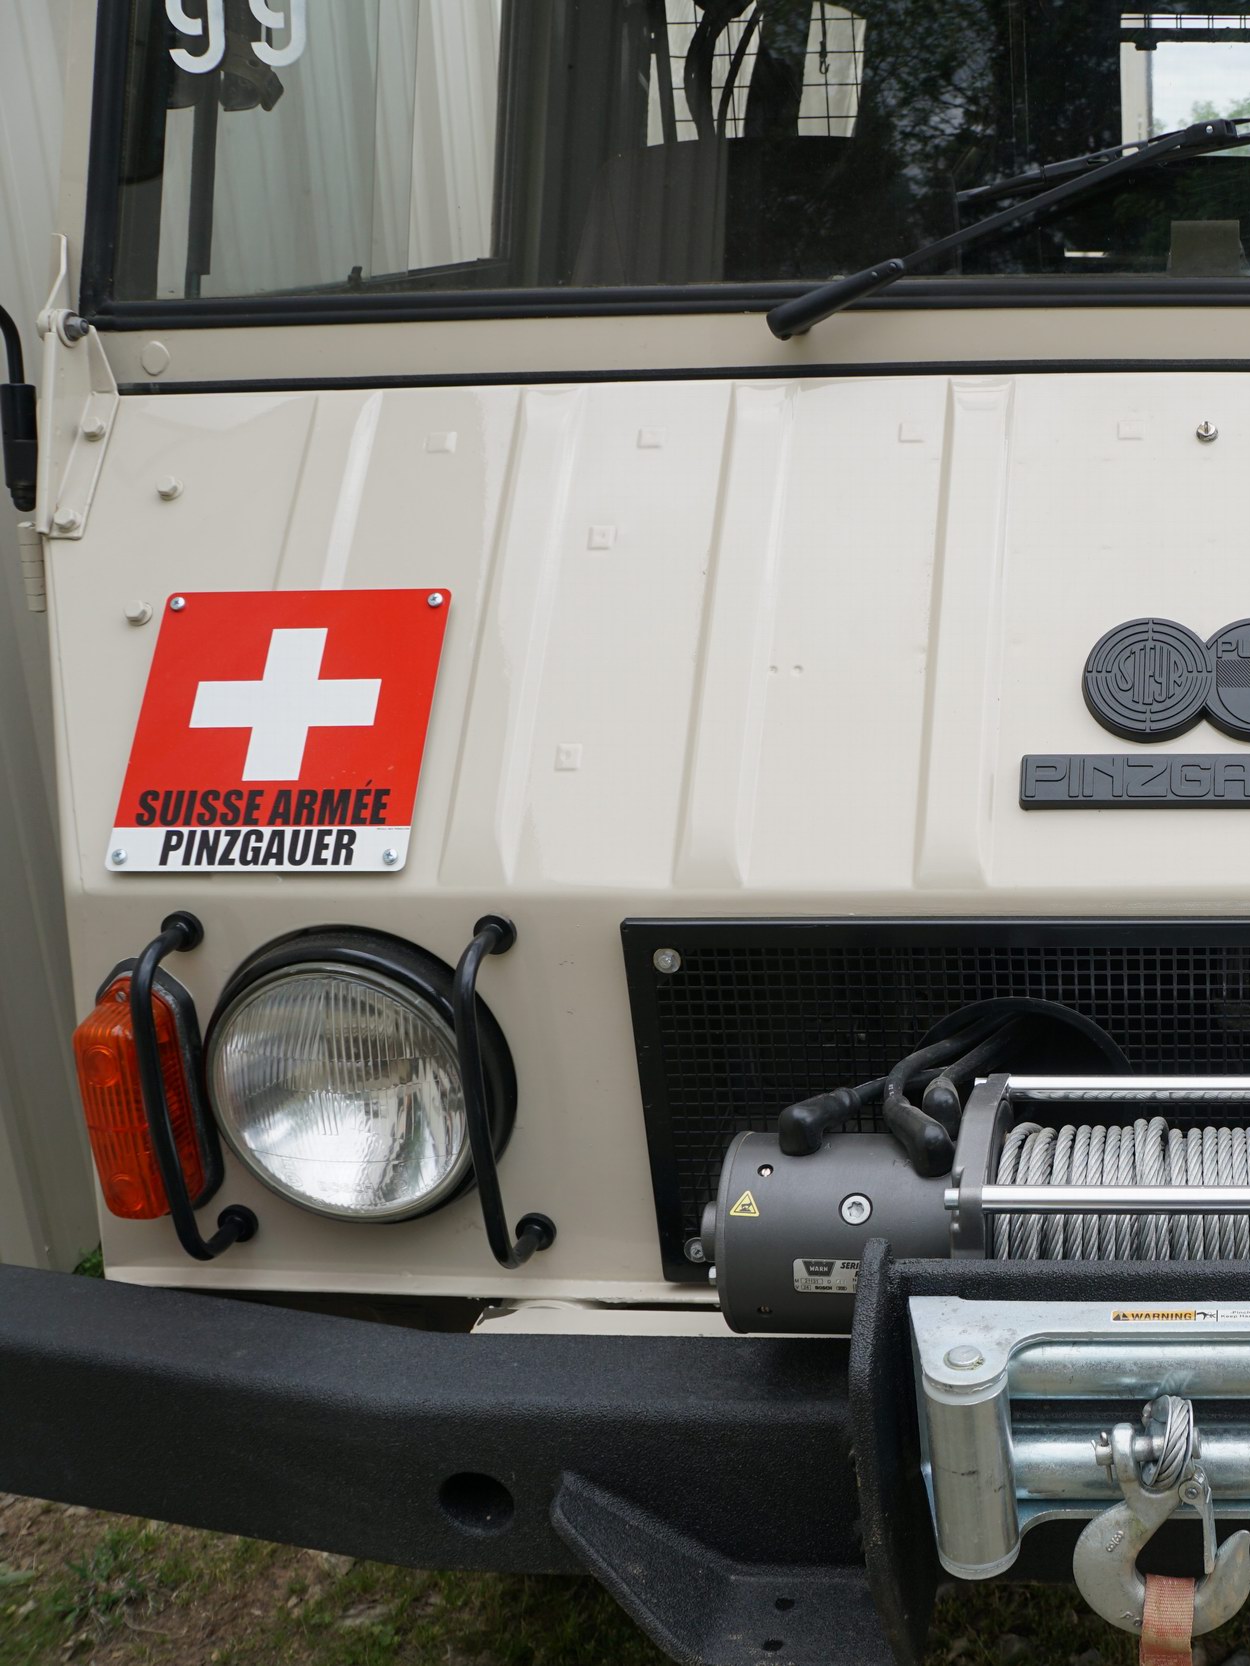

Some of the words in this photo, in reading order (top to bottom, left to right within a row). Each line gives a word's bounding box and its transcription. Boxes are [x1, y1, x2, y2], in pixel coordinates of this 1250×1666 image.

[135, 789, 264, 827] SUISSE
[267, 779, 391, 825] ARMÉE
[158, 829, 357, 866] PINZGAUER
[1131, 1312, 1192, 1321] WARNING
